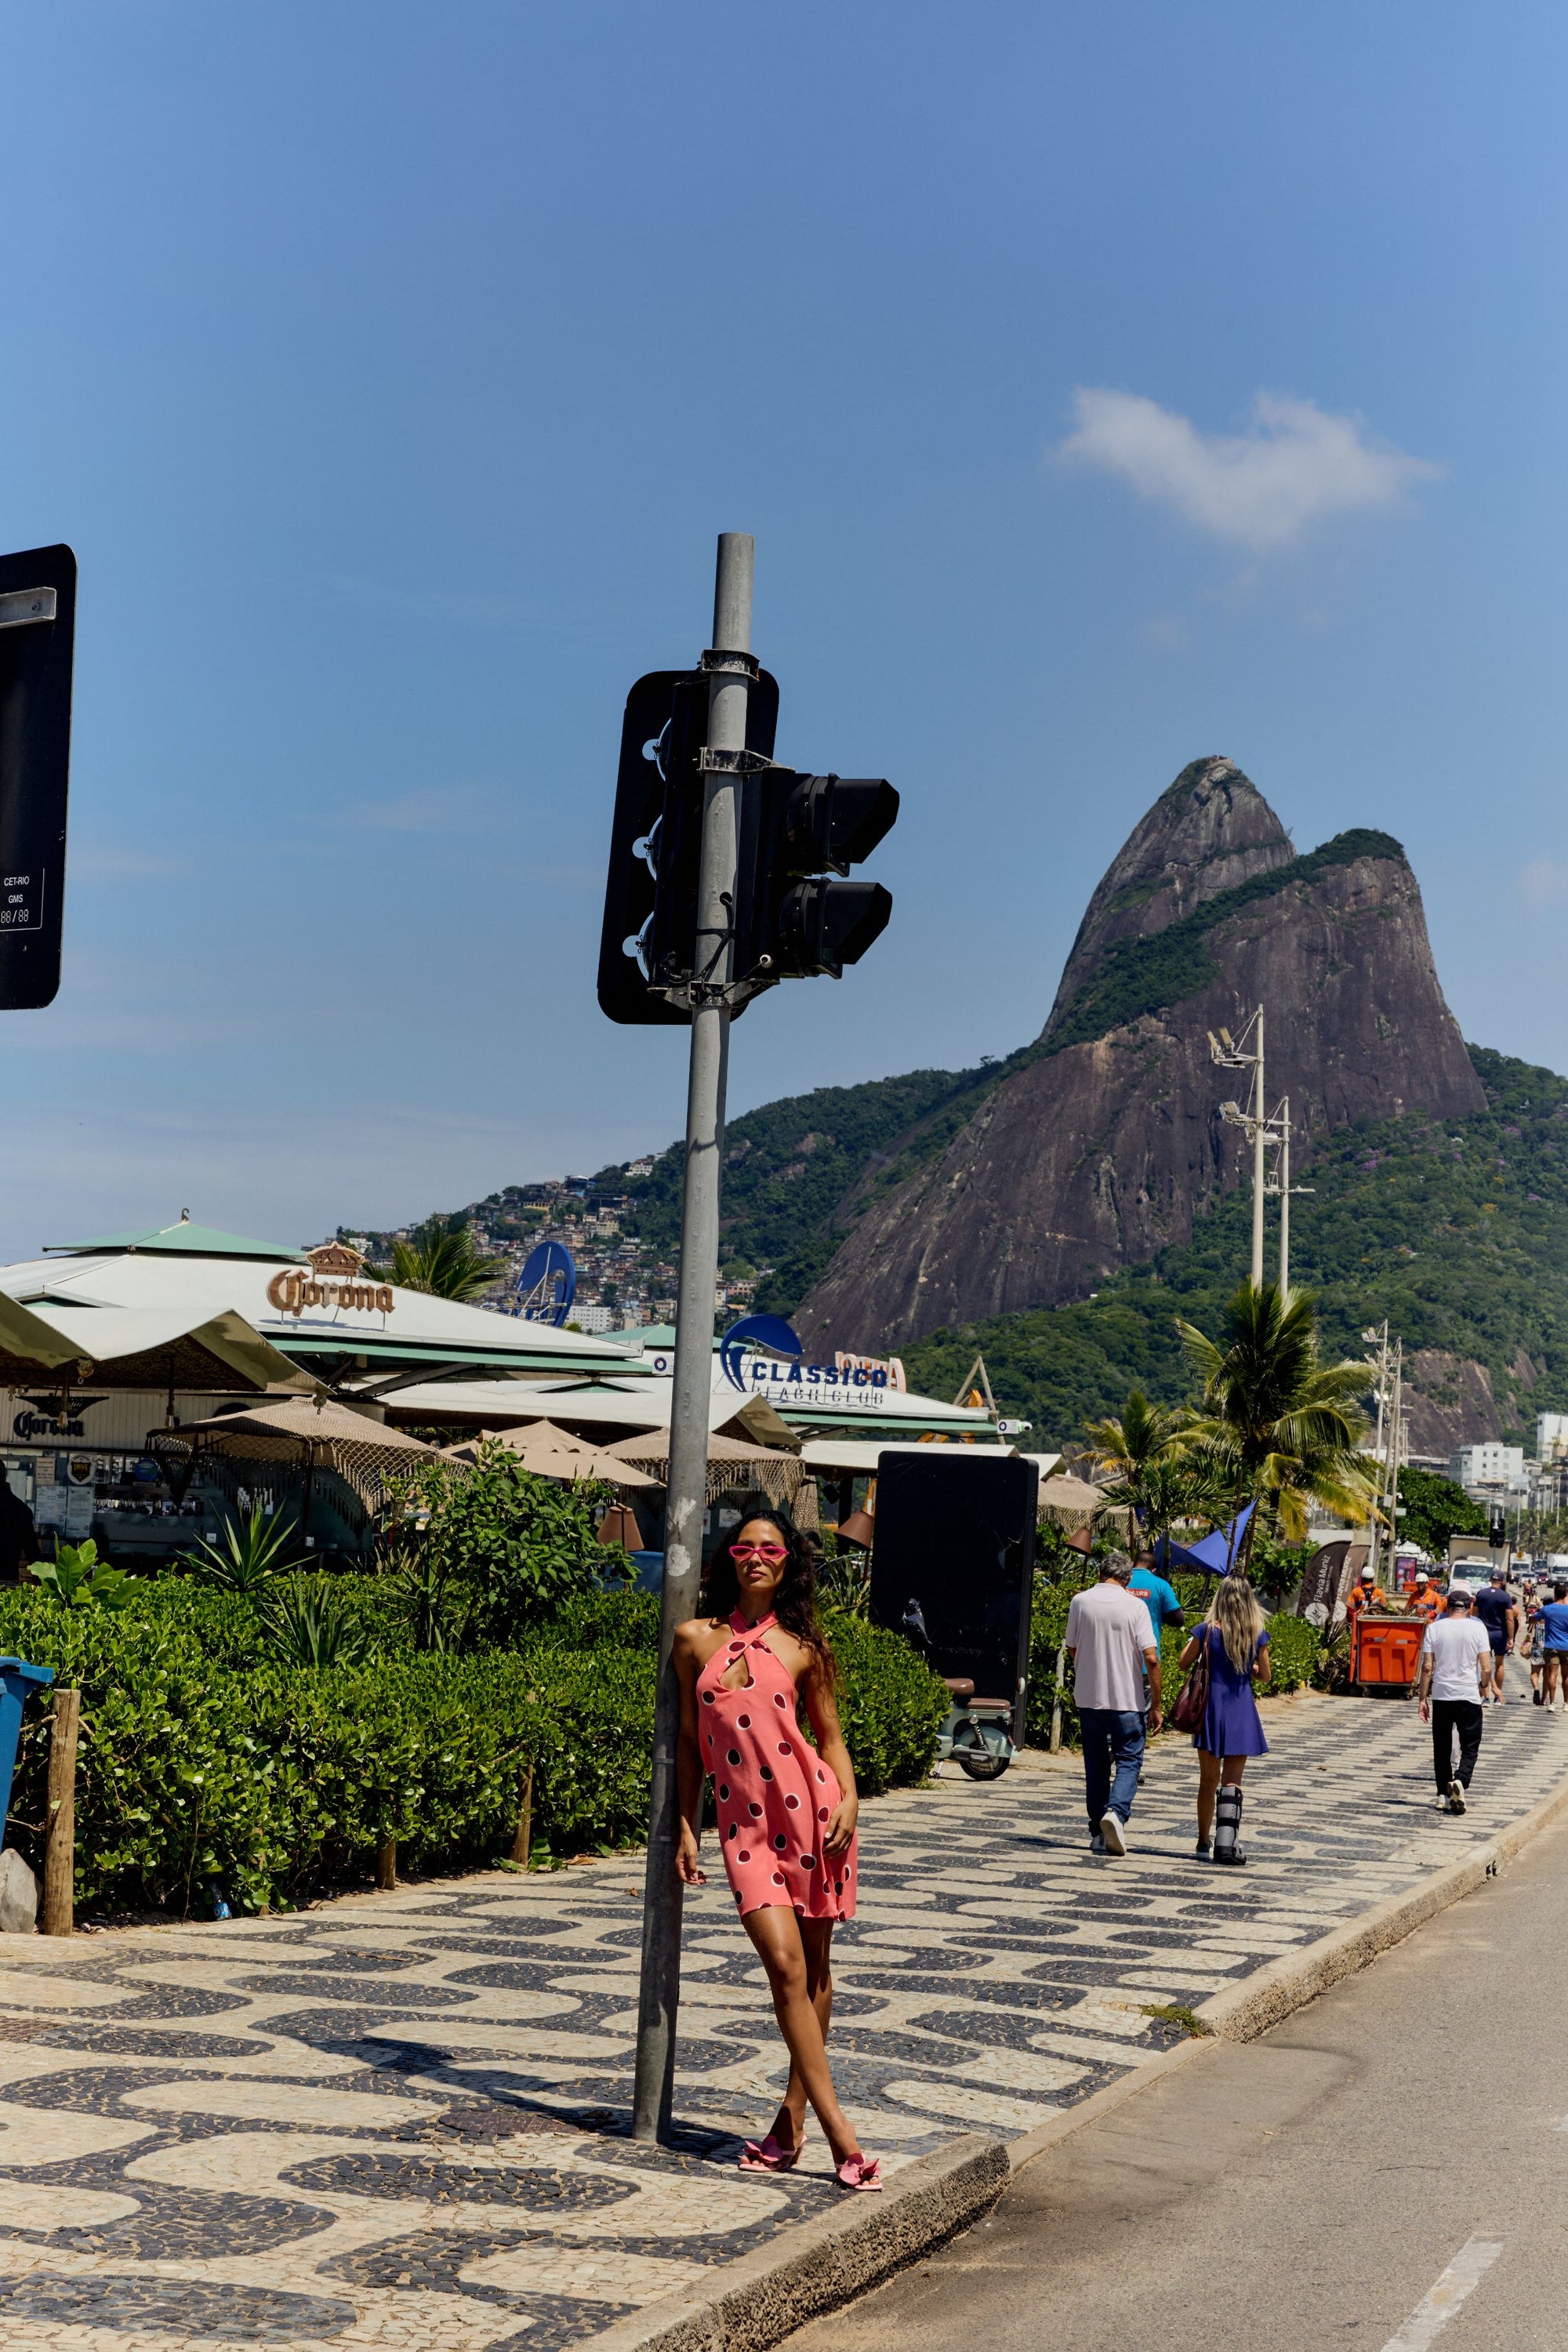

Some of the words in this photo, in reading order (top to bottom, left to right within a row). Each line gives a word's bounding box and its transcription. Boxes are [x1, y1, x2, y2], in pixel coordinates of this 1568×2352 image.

[4, 876, 30, 887] CET-RIO
[8, 894, 24, 904] GMS
[267, 1269, 396, 1318] Corona
[752, 1356, 887, 1388] CLÁSSICO
[832, 1389, 884, 1405] CLUB
[1318, 1554, 1331, 1578] Muniz
[1313, 1577, 1326, 1602] Flavia
